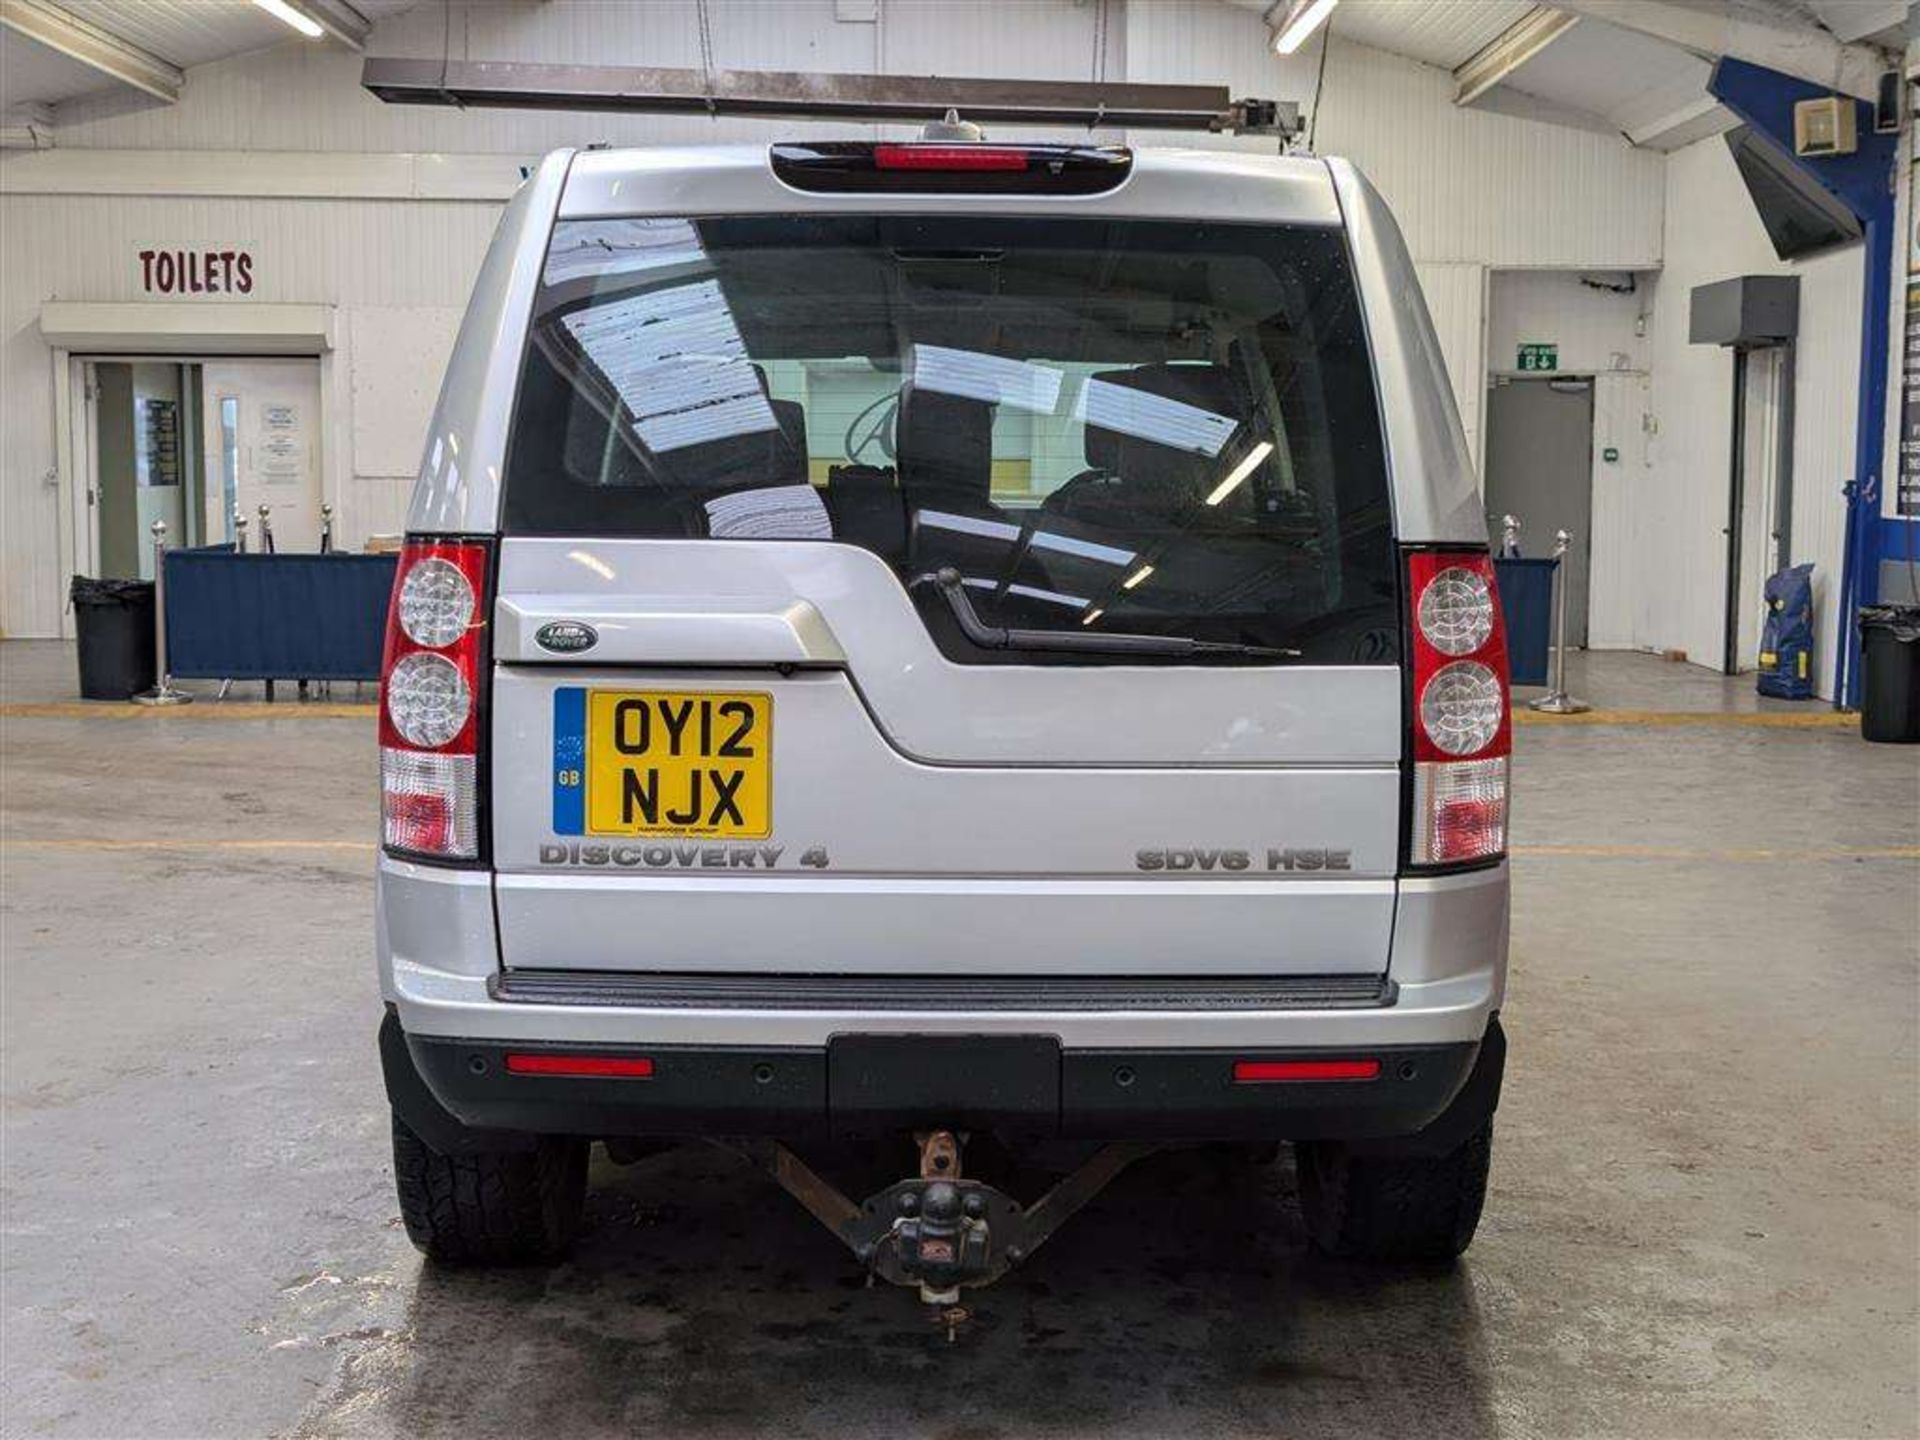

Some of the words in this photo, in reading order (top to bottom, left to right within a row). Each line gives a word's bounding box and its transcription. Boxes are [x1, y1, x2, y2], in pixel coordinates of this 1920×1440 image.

[140, 250, 254, 294] TOILETS
[614, 698, 755, 758] OY12
[558, 770, 580, 786] GB
[622, 768, 745, 826] NJX
[539, 843, 786, 868] DISCOVERY
[799, 845, 830, 868] 4
[1136, 848, 1250, 871] SDV6
[1267, 848, 1352, 871] HSE
